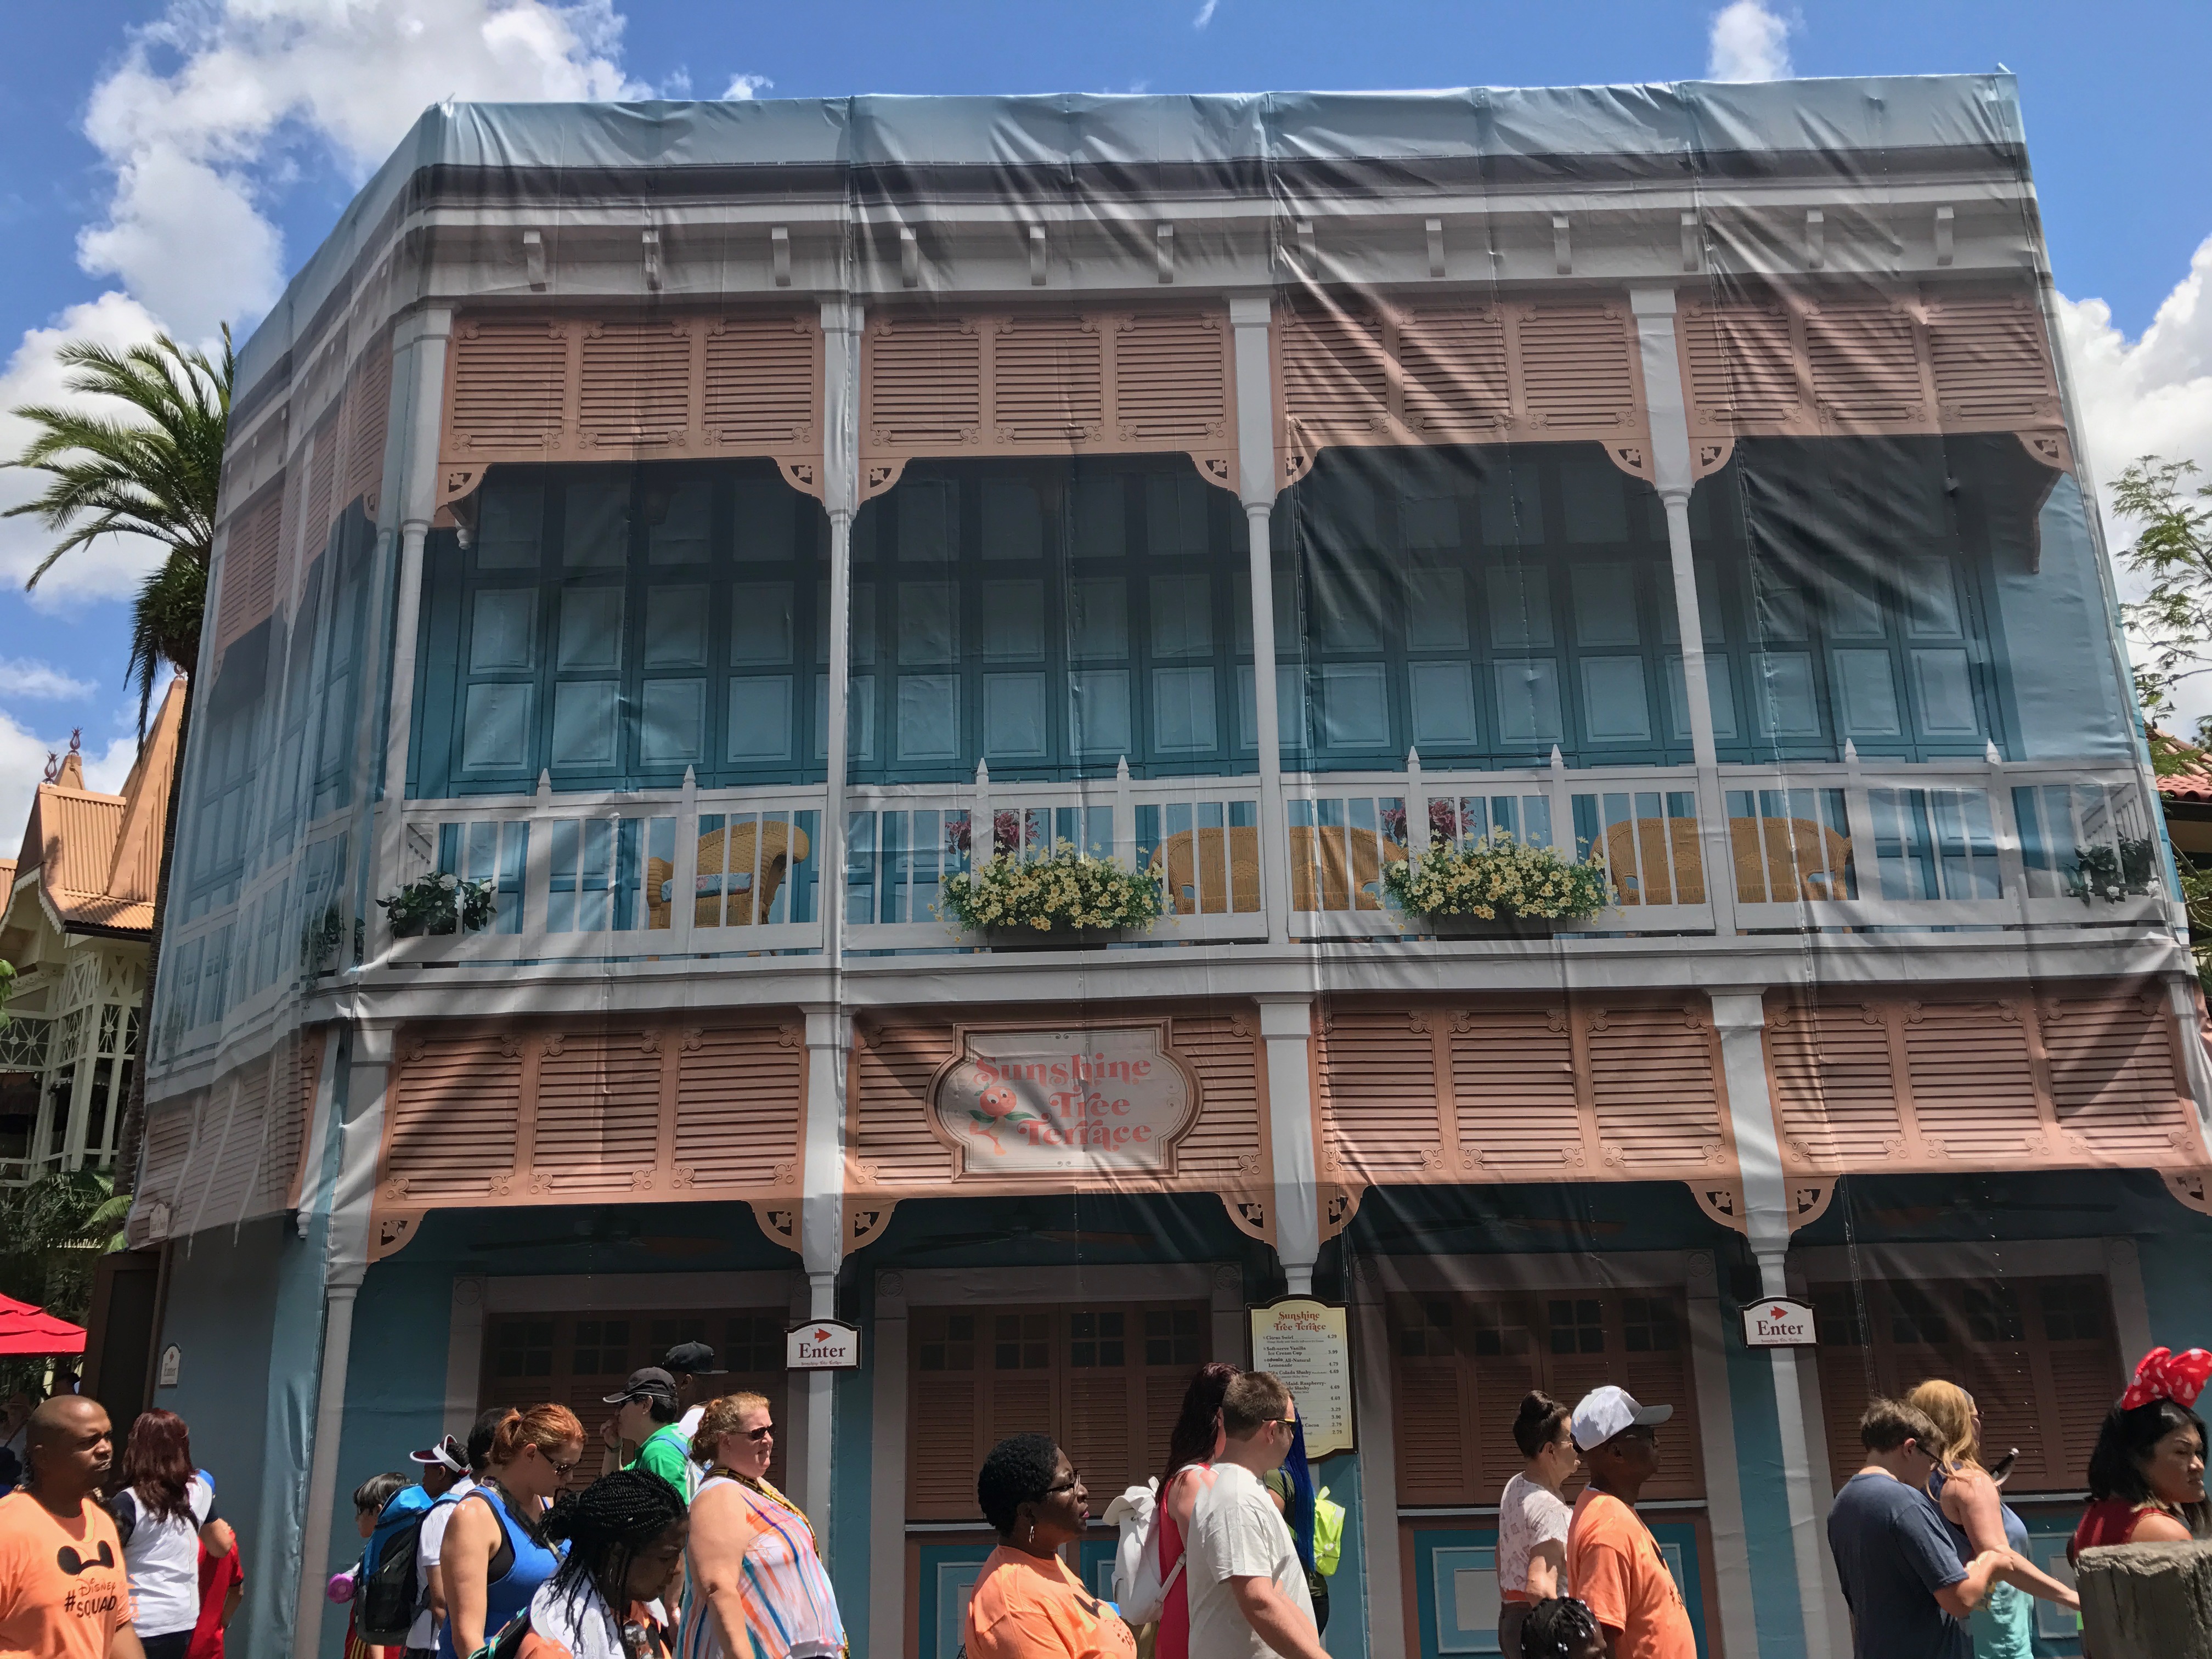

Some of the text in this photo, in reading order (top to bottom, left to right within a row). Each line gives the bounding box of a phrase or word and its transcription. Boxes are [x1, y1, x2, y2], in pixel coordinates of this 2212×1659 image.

[973, 1053, 1152, 1087] Sunshine
[1048, 1085, 1131, 1118] Tree
[1017, 1113, 1152, 1152] Terrace
[1273, 1321, 1326, 1332] Tree Terrace
[1278, 1311, 1320, 1321] Sunshine
[1756, 1320, 1804, 1335] Enter
[799, 1343, 846, 1358] Enter
[64, 1589, 117, 1618] #SQUAD
